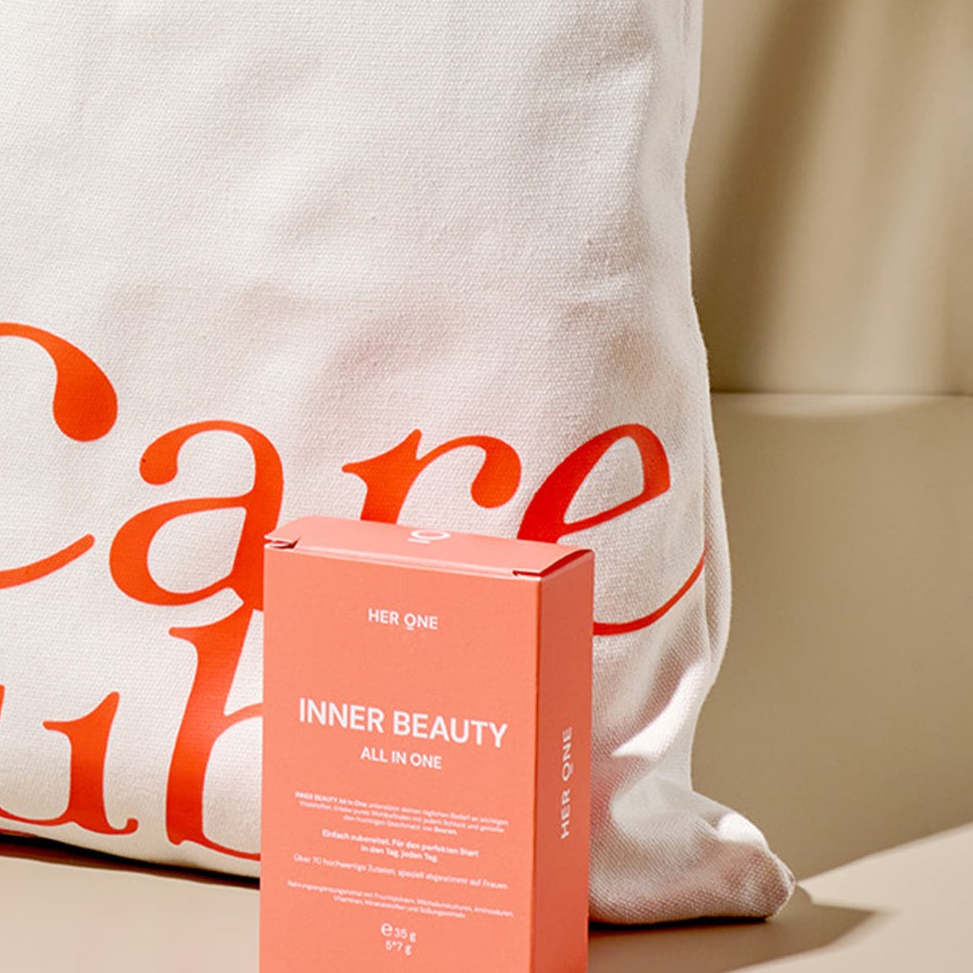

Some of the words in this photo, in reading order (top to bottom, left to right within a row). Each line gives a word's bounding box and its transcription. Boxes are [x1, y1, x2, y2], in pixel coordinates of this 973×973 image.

[368, 608, 400, 625] HER
[404, 612, 439, 631] ONE
[299, 698, 385, 733] INNER
[393, 711, 508, 748] BEAUTY
[360, 746, 389, 764] ALL
[391, 750, 407, 766] IN
[409, 752, 442, 769] ONE
[562, 727, 574, 782] ONE
[560, 789, 571, 840] HER
[394, 927, 408, 939] 35
